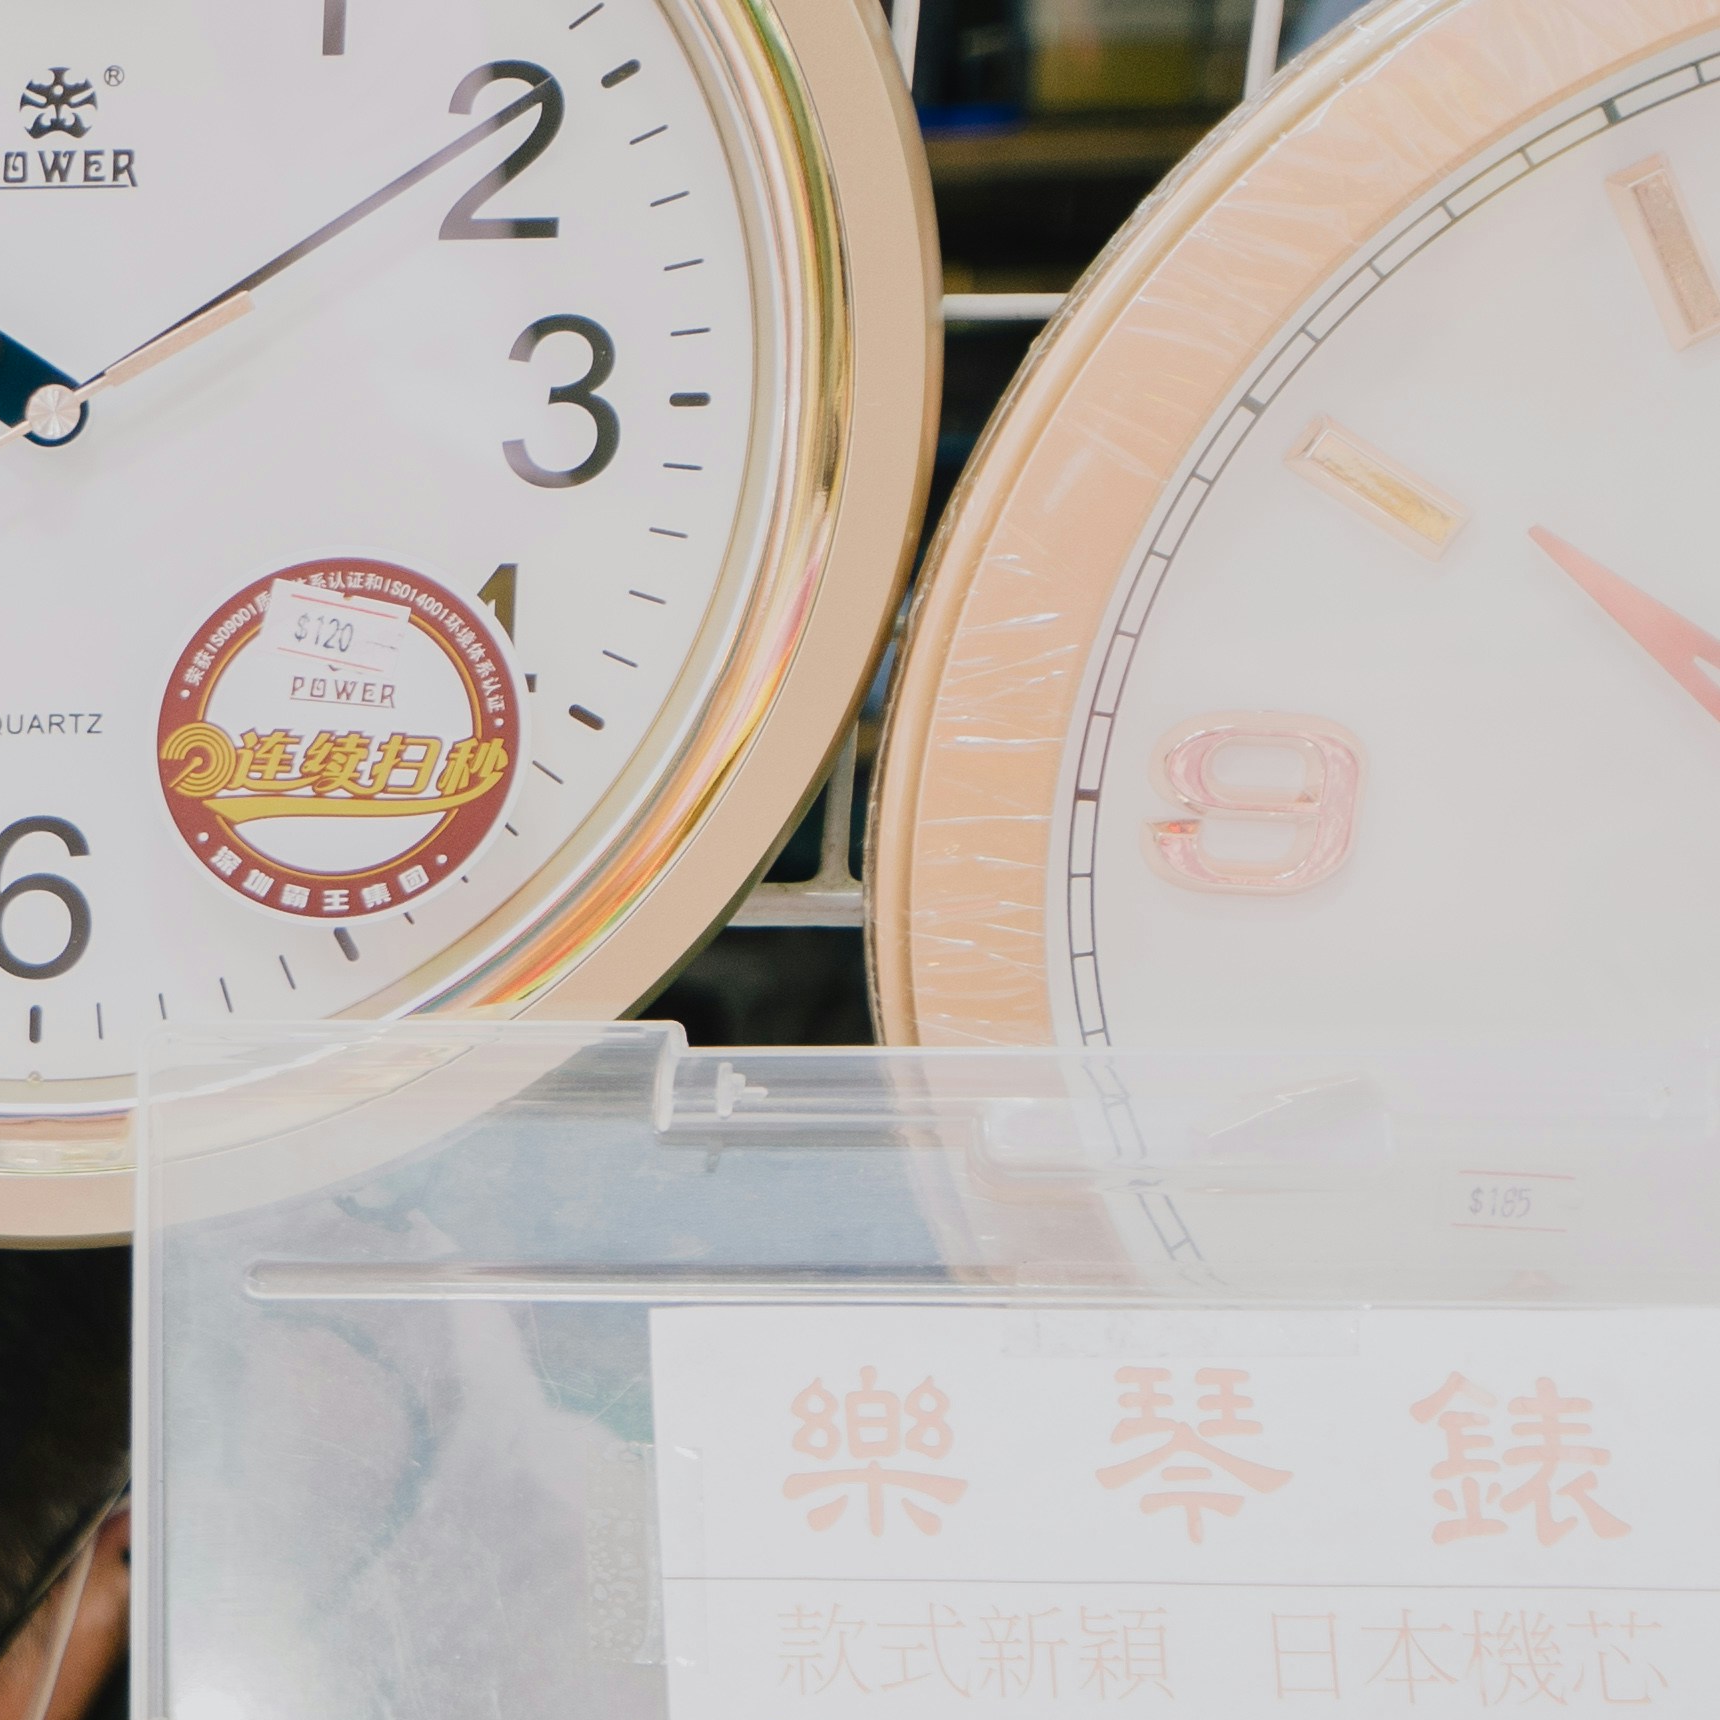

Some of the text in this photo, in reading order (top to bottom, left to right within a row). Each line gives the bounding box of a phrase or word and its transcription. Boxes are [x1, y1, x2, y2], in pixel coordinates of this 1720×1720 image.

[437, 58, 568, 241] 2
[500, 312, 621, 490] 3
[293, 613, 355, 652] $120
[291, 676, 396, 706] POWER
[1270, 1608, 1669, 1706] 日本機芯
